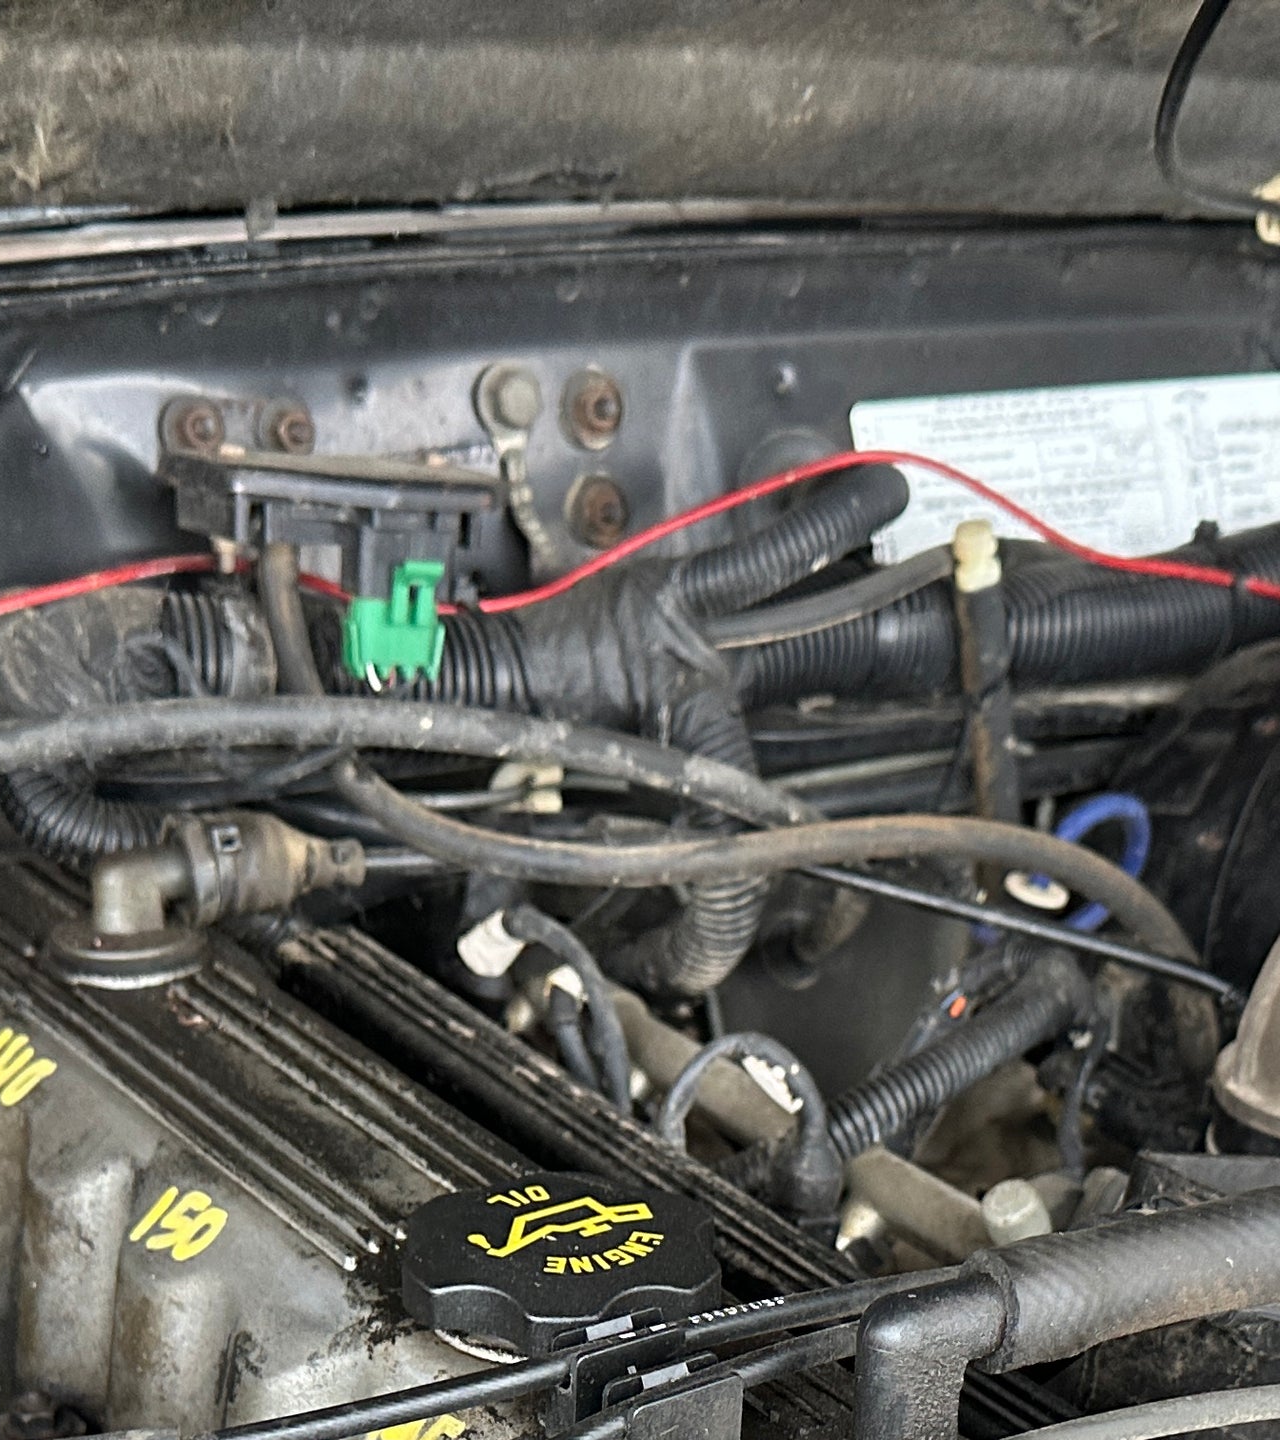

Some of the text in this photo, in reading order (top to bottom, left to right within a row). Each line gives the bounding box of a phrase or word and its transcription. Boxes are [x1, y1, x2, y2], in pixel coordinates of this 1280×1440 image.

[130, 1185, 229, 1261] 150
[486, 1185, 664, 1274] OIL ENGINE
